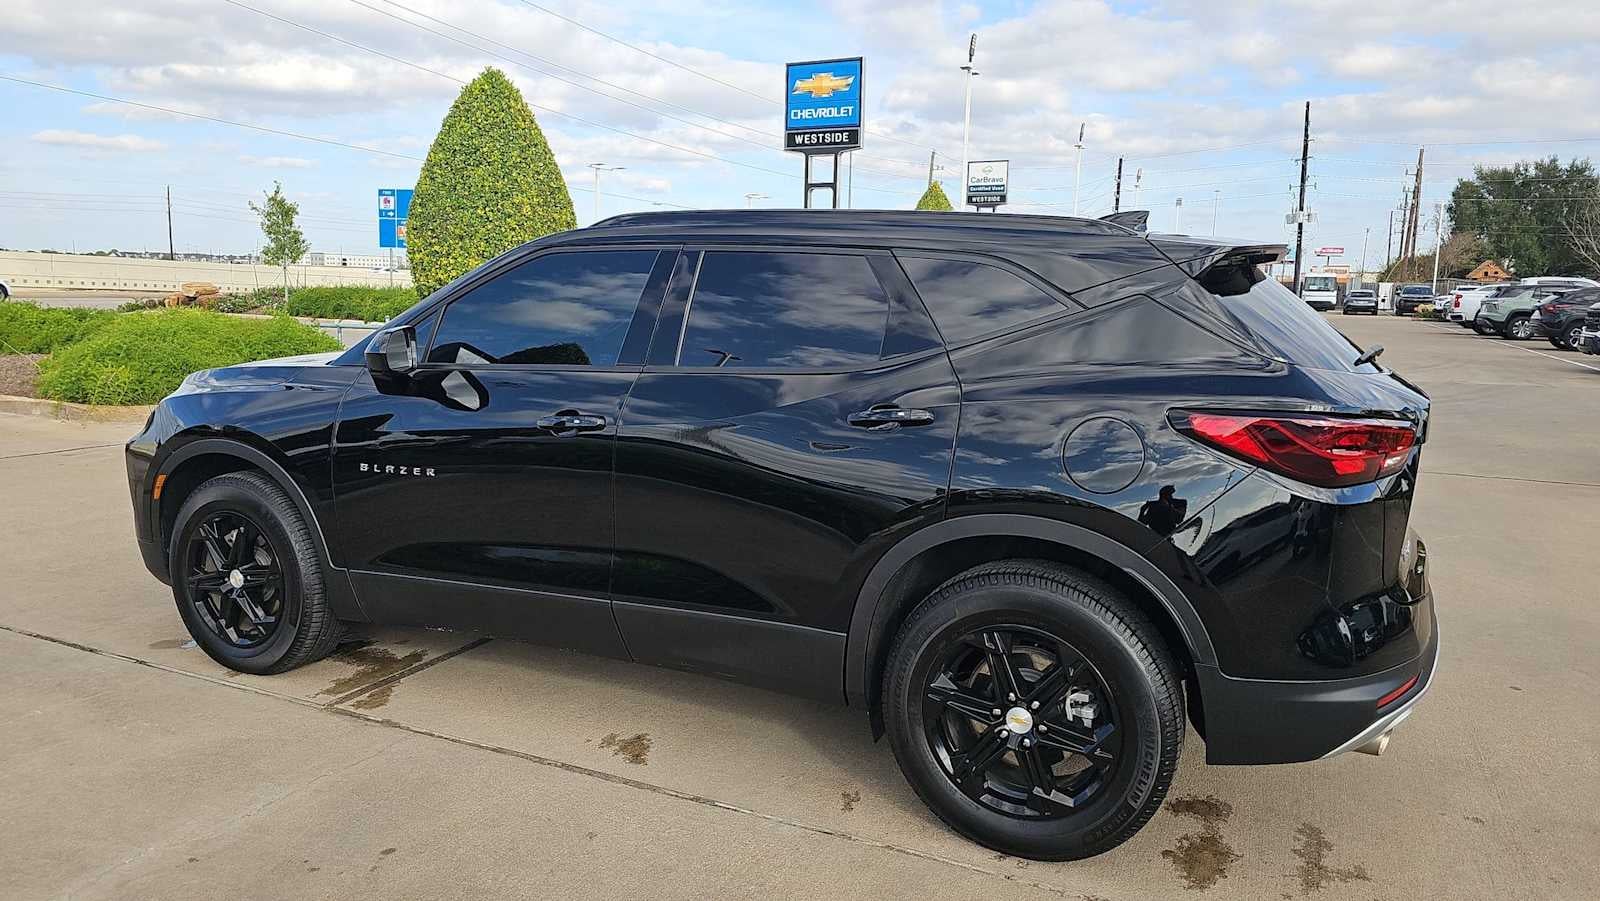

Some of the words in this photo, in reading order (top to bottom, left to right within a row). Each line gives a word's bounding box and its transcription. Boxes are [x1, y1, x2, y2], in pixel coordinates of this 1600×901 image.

[791, 105, 854, 120] CHEVROLET
[795, 132, 849, 145] WESTSIDE
[971, 195, 1001, 203] WESTSIDE
[360, 462, 436, 477] BLAZER
[1129, 732, 1156, 806] MICHELIN
